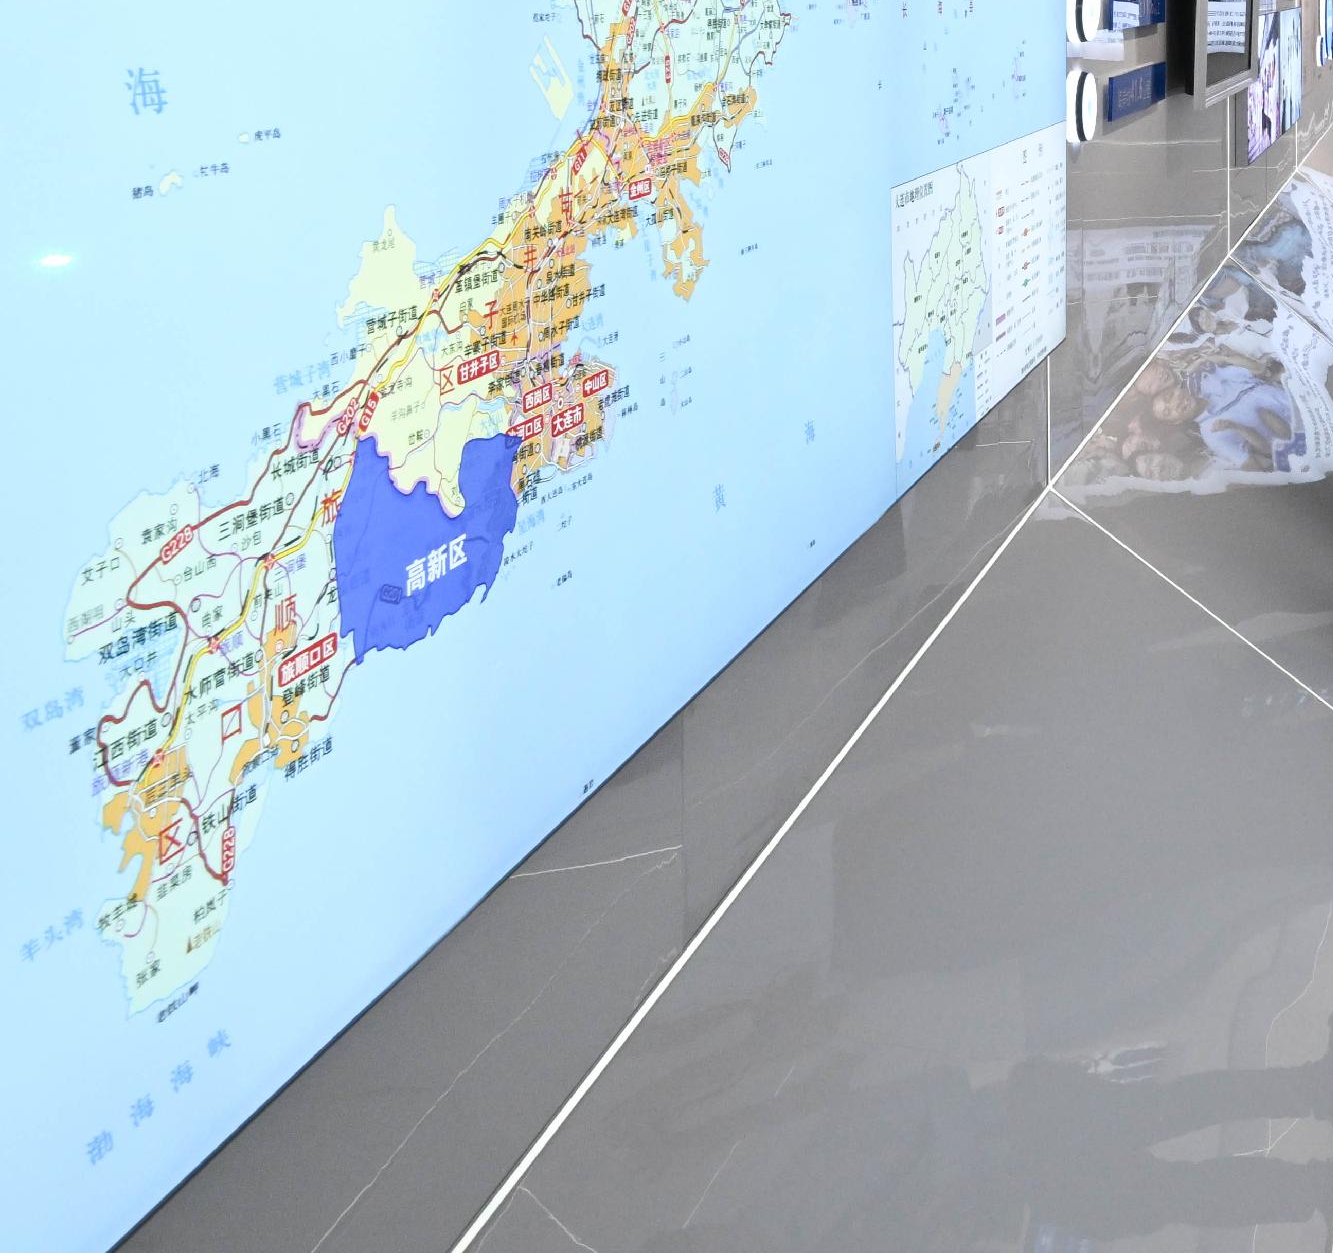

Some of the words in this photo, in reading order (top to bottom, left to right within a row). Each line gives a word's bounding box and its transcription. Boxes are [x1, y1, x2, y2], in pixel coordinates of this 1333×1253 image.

[124, 66, 169, 115] 海
[573, 149, 588, 173] G11
[630, 181, 651, 197] 金州区
[366, 306, 418, 335] 营城子街道
[460, 352, 499, 382] 甘井子区
[584, 372, 609, 395] 中山区
[361, 394, 379, 427] G15
[525, 385, 552, 411] 西岗区
[337, 398, 359, 434] G202
[553, 406, 583, 434] 大连市
[271, 449, 320, 480] 长城街道
[218, 496, 286, 542] 三涧堡街道
[161, 527, 194, 562] G228
[404, 533, 469, 597] 高新区
[98, 612, 178, 665] 双岛湾街道
[185, 650, 255, 699] 水师营街道
[279, 635, 336, 683] 旅顺口区
[282, 665, 330, 707] 登峰街道
